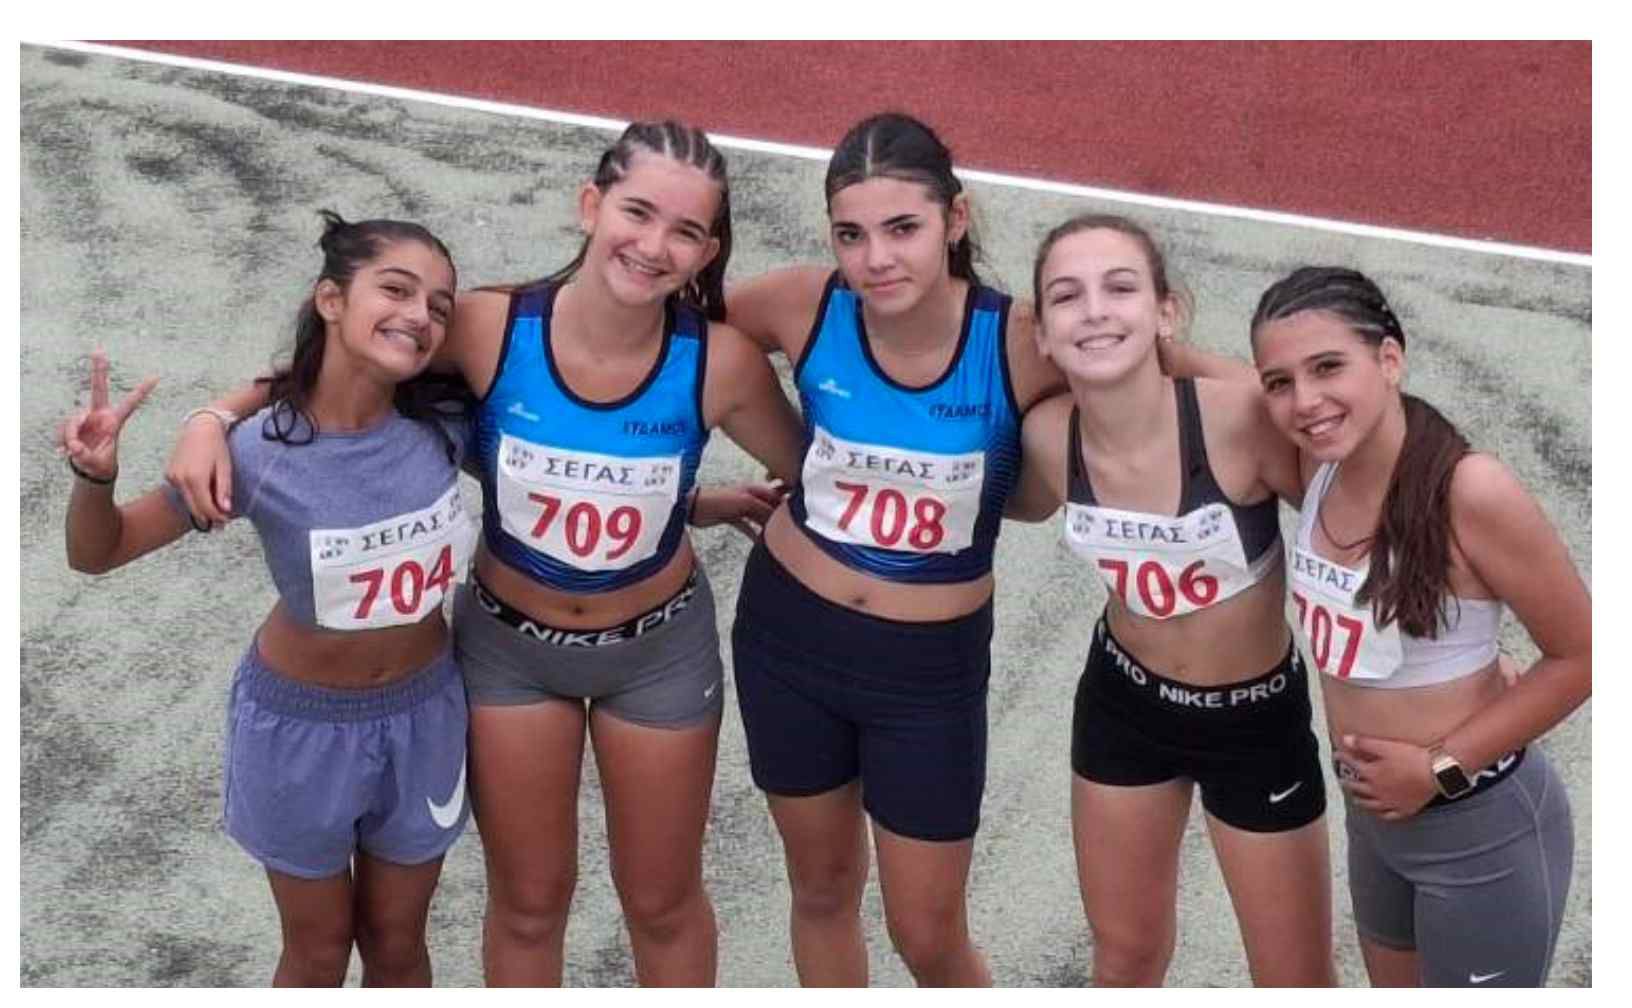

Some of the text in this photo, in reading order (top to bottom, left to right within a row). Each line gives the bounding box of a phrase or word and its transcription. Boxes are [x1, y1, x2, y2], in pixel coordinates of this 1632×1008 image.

[545, 457, 635, 486] ΣΕΓΑΣ
[847, 451, 936, 480] ΣΕΓΑΣ
[361, 510, 442, 551] ΣΕΓΑΣ
[527, 492, 642, 561] 709
[834, 480, 946, 550] 708
[1106, 518, 1188, 543] ΣΕΓΑΣ
[349, 544, 455, 619] 704
[1097, 559, 1220, 618] 706
[1295, 552, 1356, 592] ΣΕΓΑΣ
[519, 621, 625, 647] NIKE
[1159, 683, 1224, 708] NIKE
[1230, 673, 1287, 706] PRO
